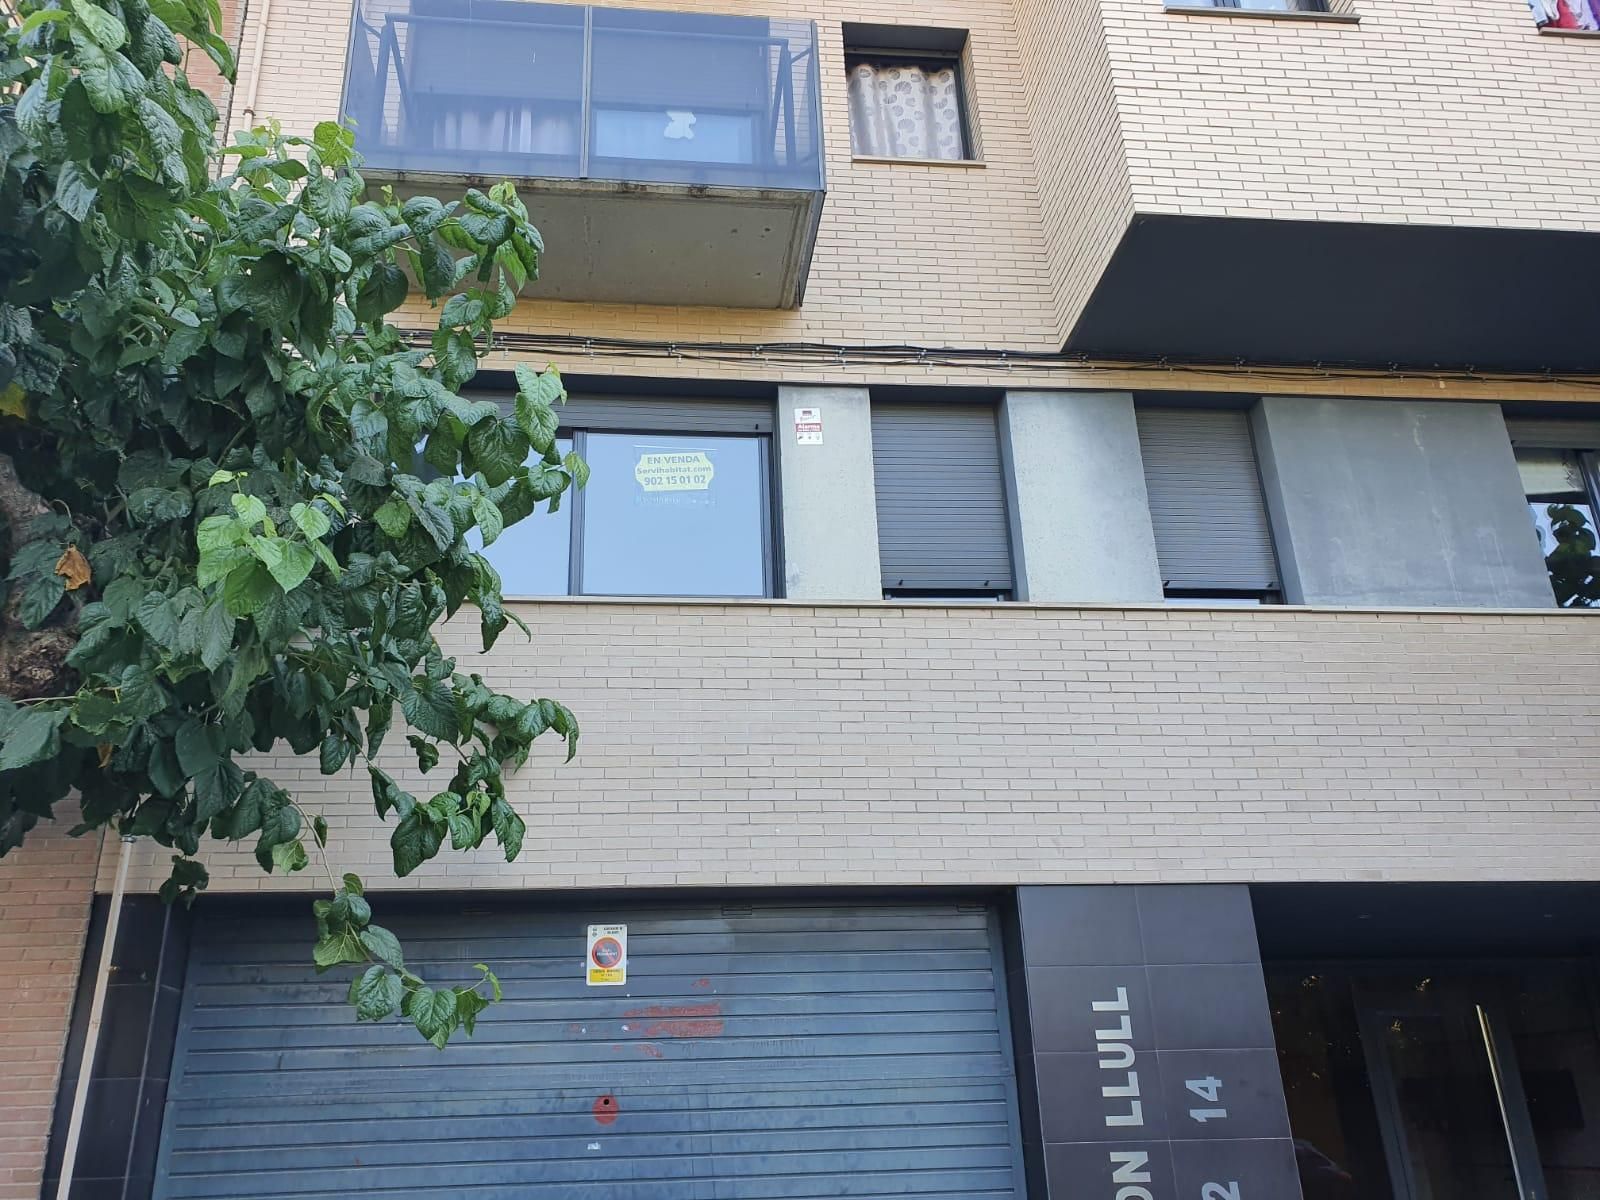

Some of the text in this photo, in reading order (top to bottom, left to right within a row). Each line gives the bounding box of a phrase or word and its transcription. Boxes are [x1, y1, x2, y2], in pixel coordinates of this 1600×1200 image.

[647, 455, 700, 464] EN VENDA
[644, 474, 706, 486] 902 15 01 02
[1091, 987, 1144, 1127] LLULL
[1185, 1076, 1228, 1122] 14
